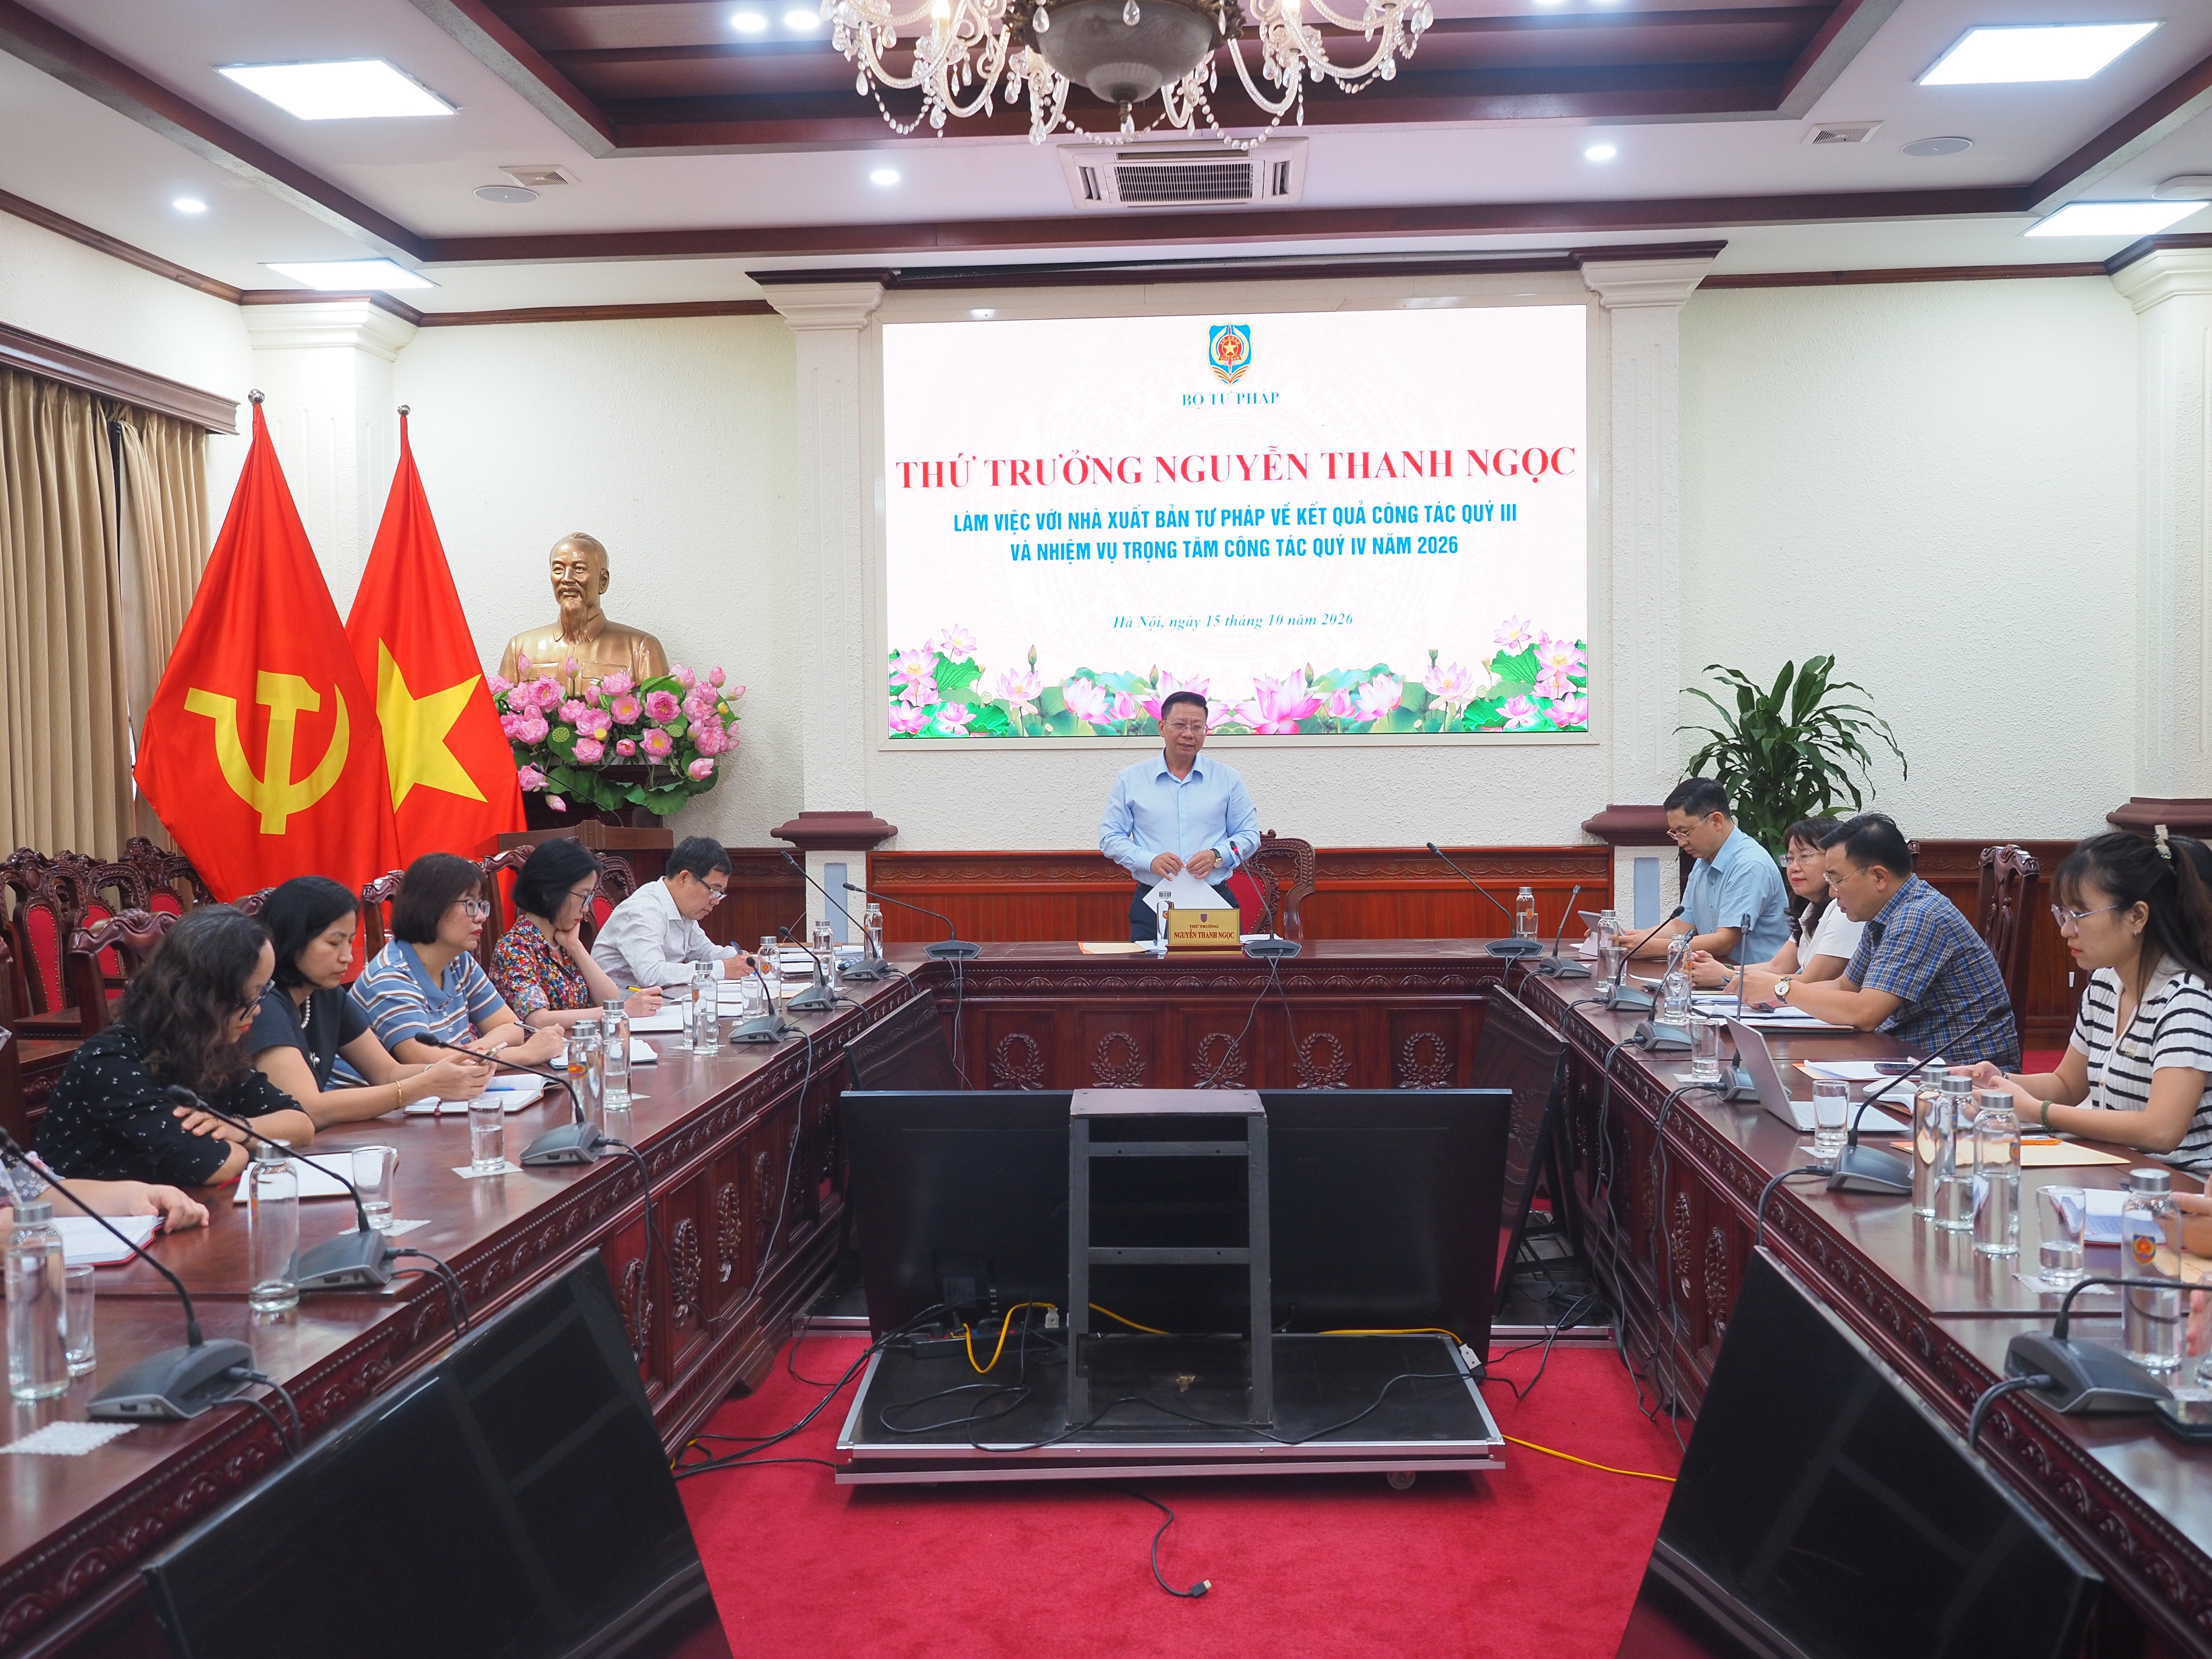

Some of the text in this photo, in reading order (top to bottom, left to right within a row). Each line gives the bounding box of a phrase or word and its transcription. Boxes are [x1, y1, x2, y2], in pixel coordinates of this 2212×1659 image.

[1182, 389, 1279, 409] BỘ TƯ PHÁP
[896, 445, 1576, 488] THỨ TRƯỞNG NGUYỄN THANH NGỌC
[954, 500, 1517, 535] LÀM VIỆC VỚI NHÀ XUẤT BẢN TƯ PHÁP VỀ KẾT QUẢ CÔNG TÁC QUÝ III
[1011, 533, 1458, 564] VÀ NHIỆM VỤ TRỌNG TÂM CÔNG TÁC QUÝ IV NĂM 2026
[1113, 613, 1353, 631] Hà Nội, ngày 15 tháng 10 năm 2026
[1173, 929, 1196, 938] NGUYỄN
[1218, 931, 1234, 940] NGỌC
